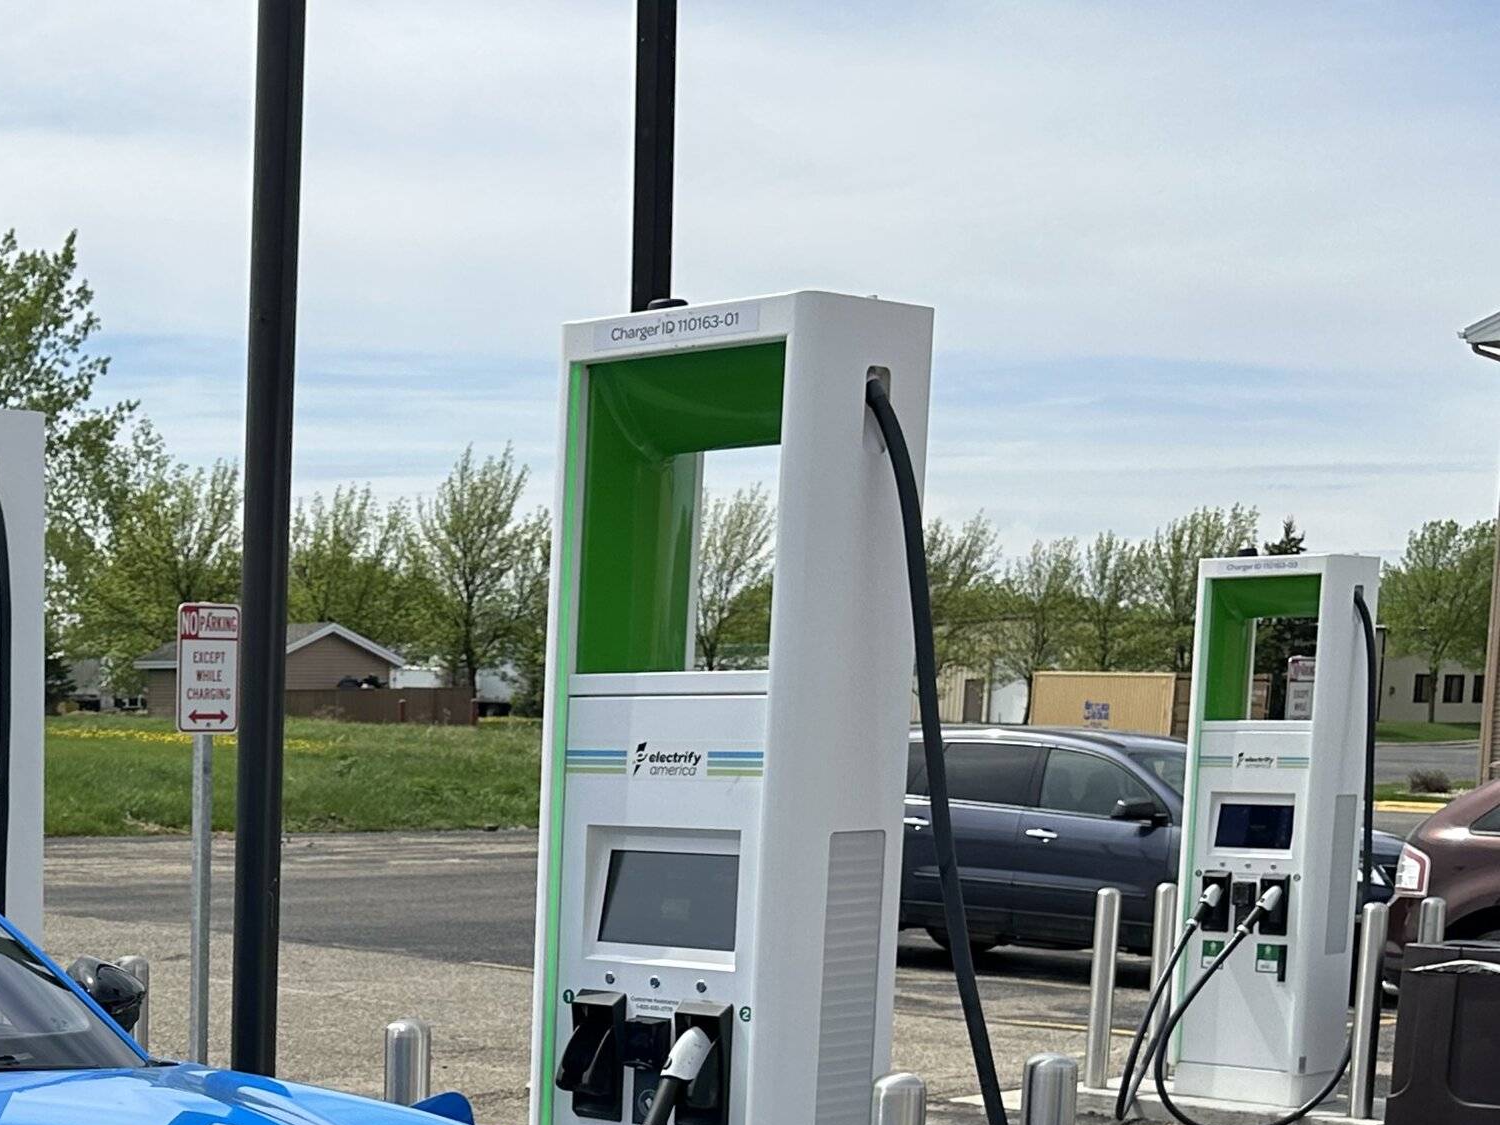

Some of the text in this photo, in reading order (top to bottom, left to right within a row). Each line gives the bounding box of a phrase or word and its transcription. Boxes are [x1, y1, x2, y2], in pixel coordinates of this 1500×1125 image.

[611, 312, 739, 341] Charger ID 110163-01
[181, 611, 238, 636] NO PARKING
[192, 651, 226, 665] EXCEPT
[196, 669, 222, 682] WHILE
[186, 687, 232, 701] CHARGING
[648, 751, 702, 766] electrify
[649, 765, 698, 777] america
